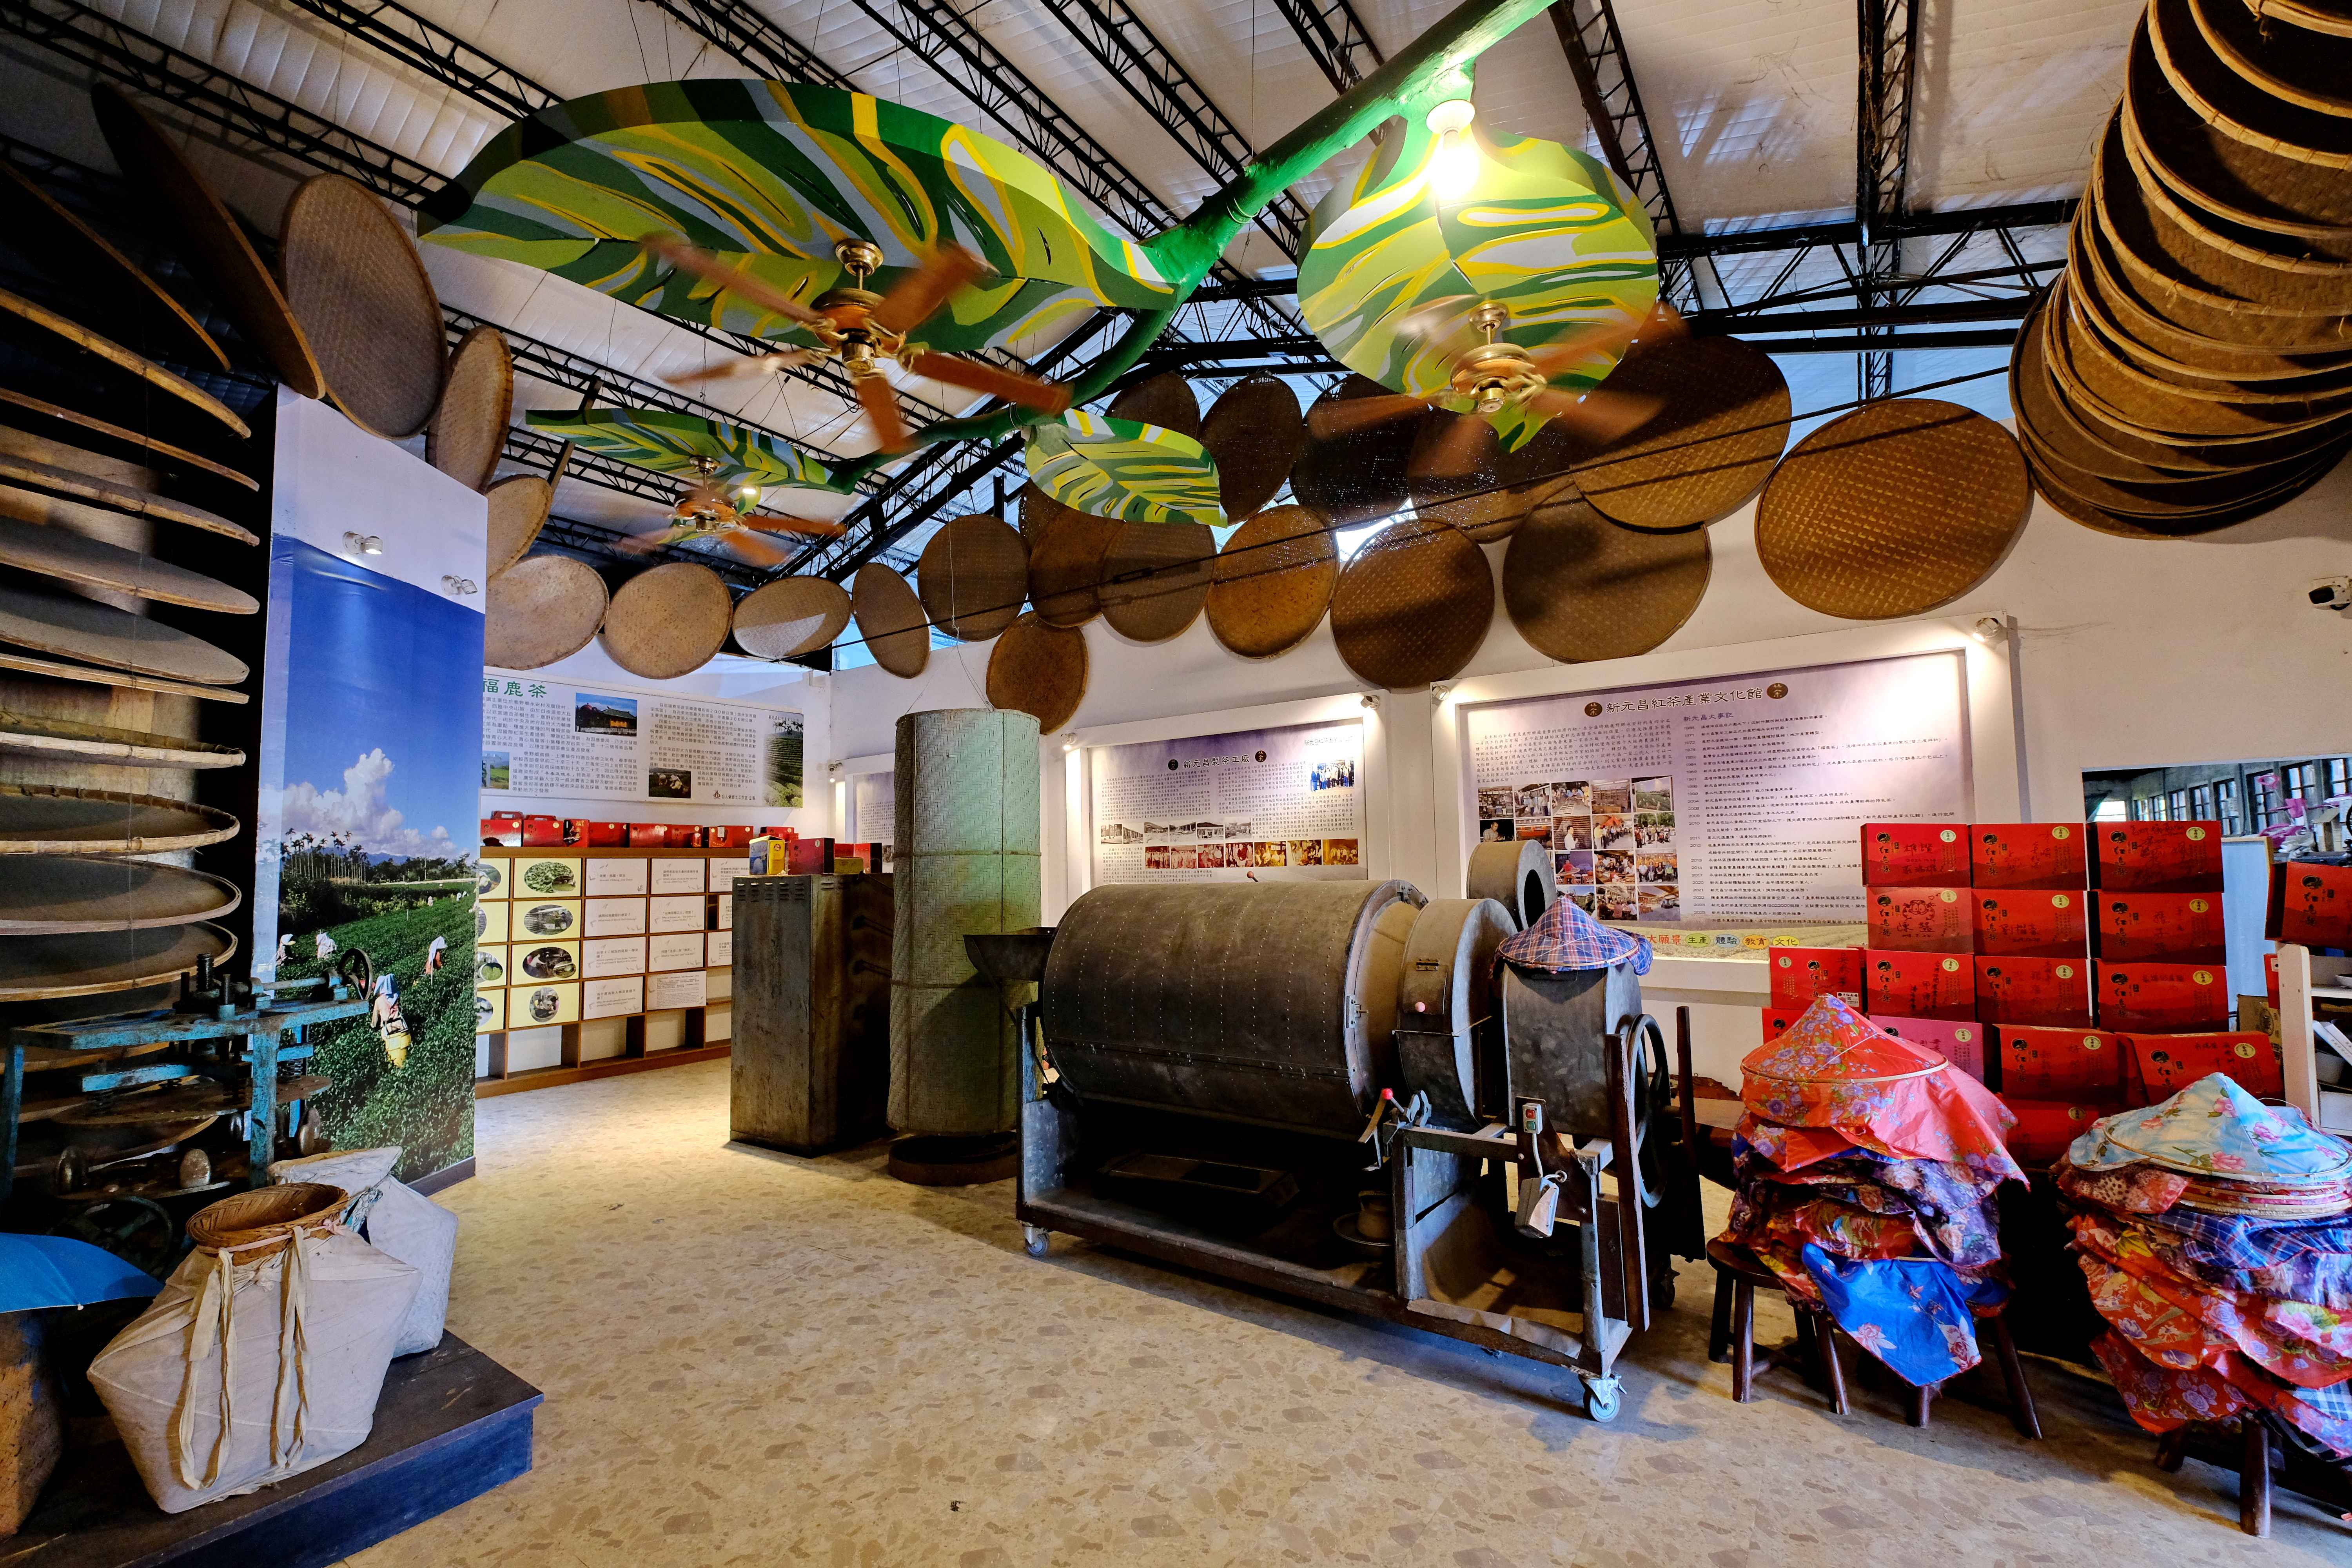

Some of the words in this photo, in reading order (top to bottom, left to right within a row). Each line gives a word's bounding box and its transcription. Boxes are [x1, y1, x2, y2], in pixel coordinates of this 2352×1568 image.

[1606, 688, 1763, 713] 新元昌紅茶產業文化館
[1684, 712, 1733, 722] 新元昌大事記
[1183, 754, 1250, 769] 新元昌製茶工廠
[1715, 936, 1740, 945] 體驗
[1745, 937, 1767, 946] 教育
